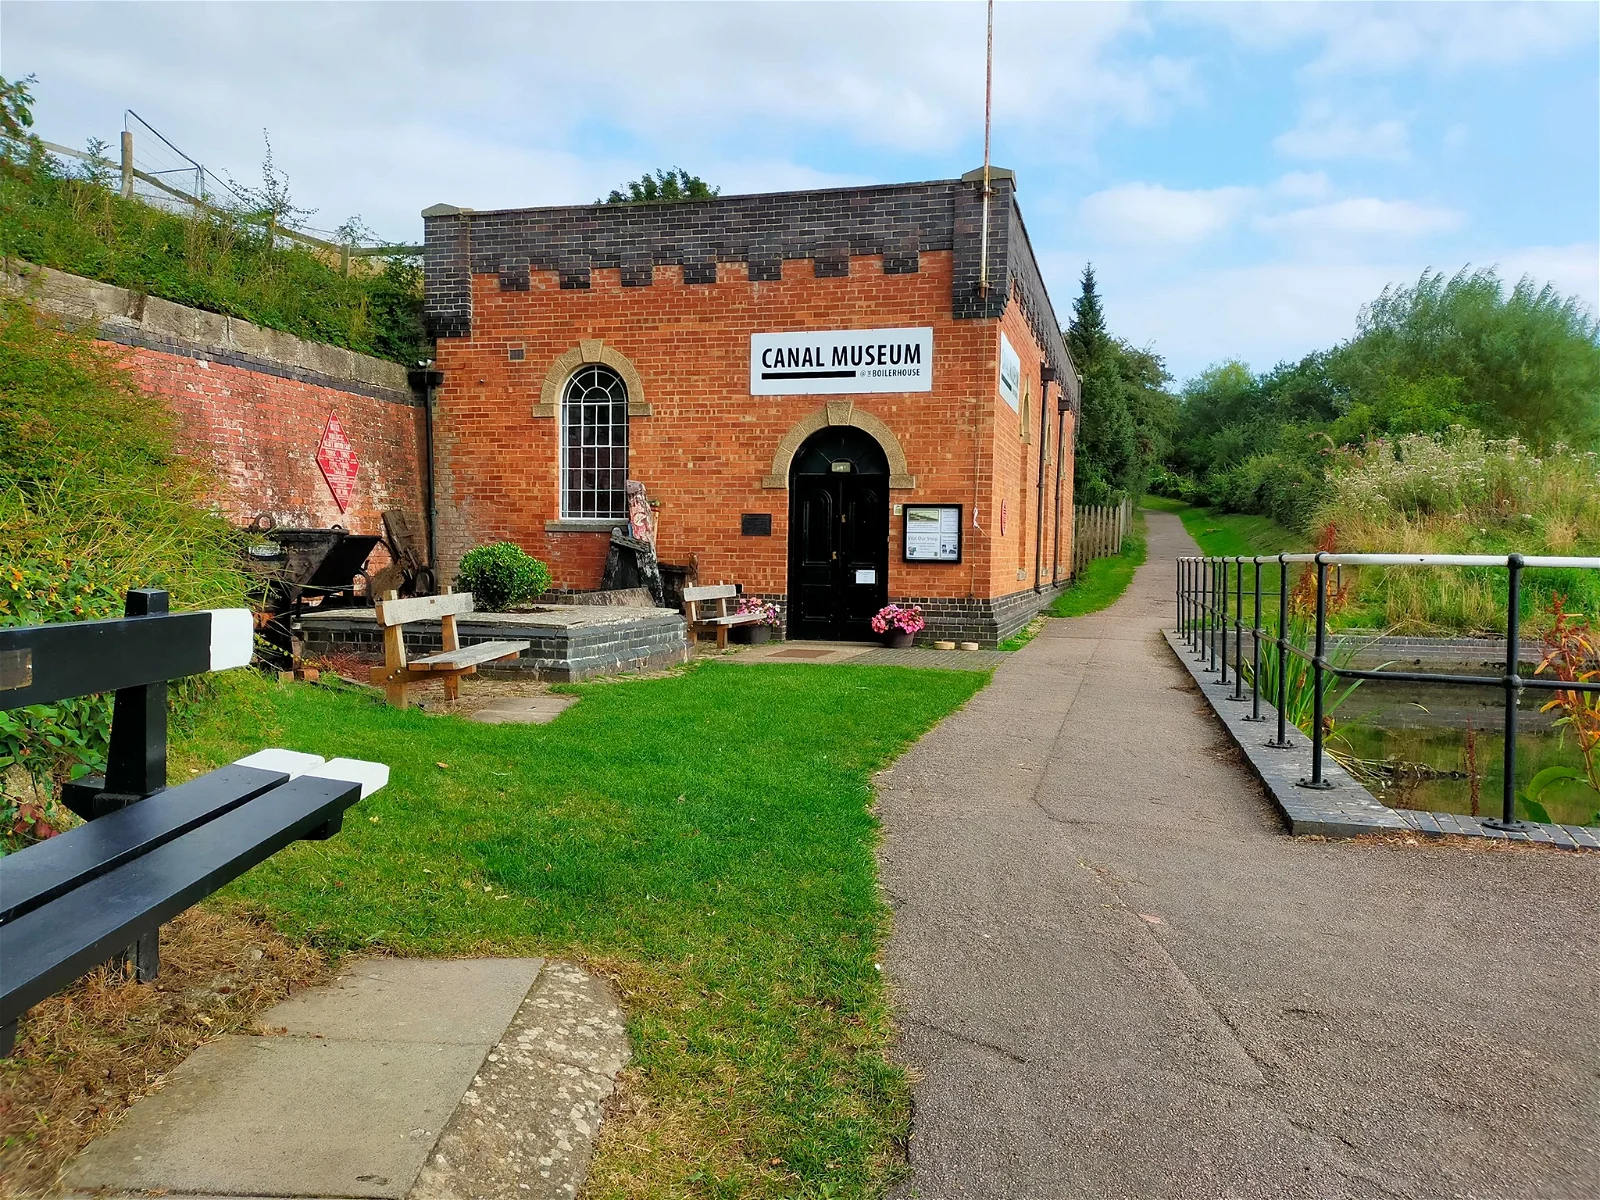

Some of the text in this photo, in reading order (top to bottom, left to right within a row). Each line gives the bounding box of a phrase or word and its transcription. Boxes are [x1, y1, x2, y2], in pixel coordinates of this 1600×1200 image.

[762, 344, 921, 368] CANAL MUSEUM
[872, 369, 920, 378] BOILERHOUSE
